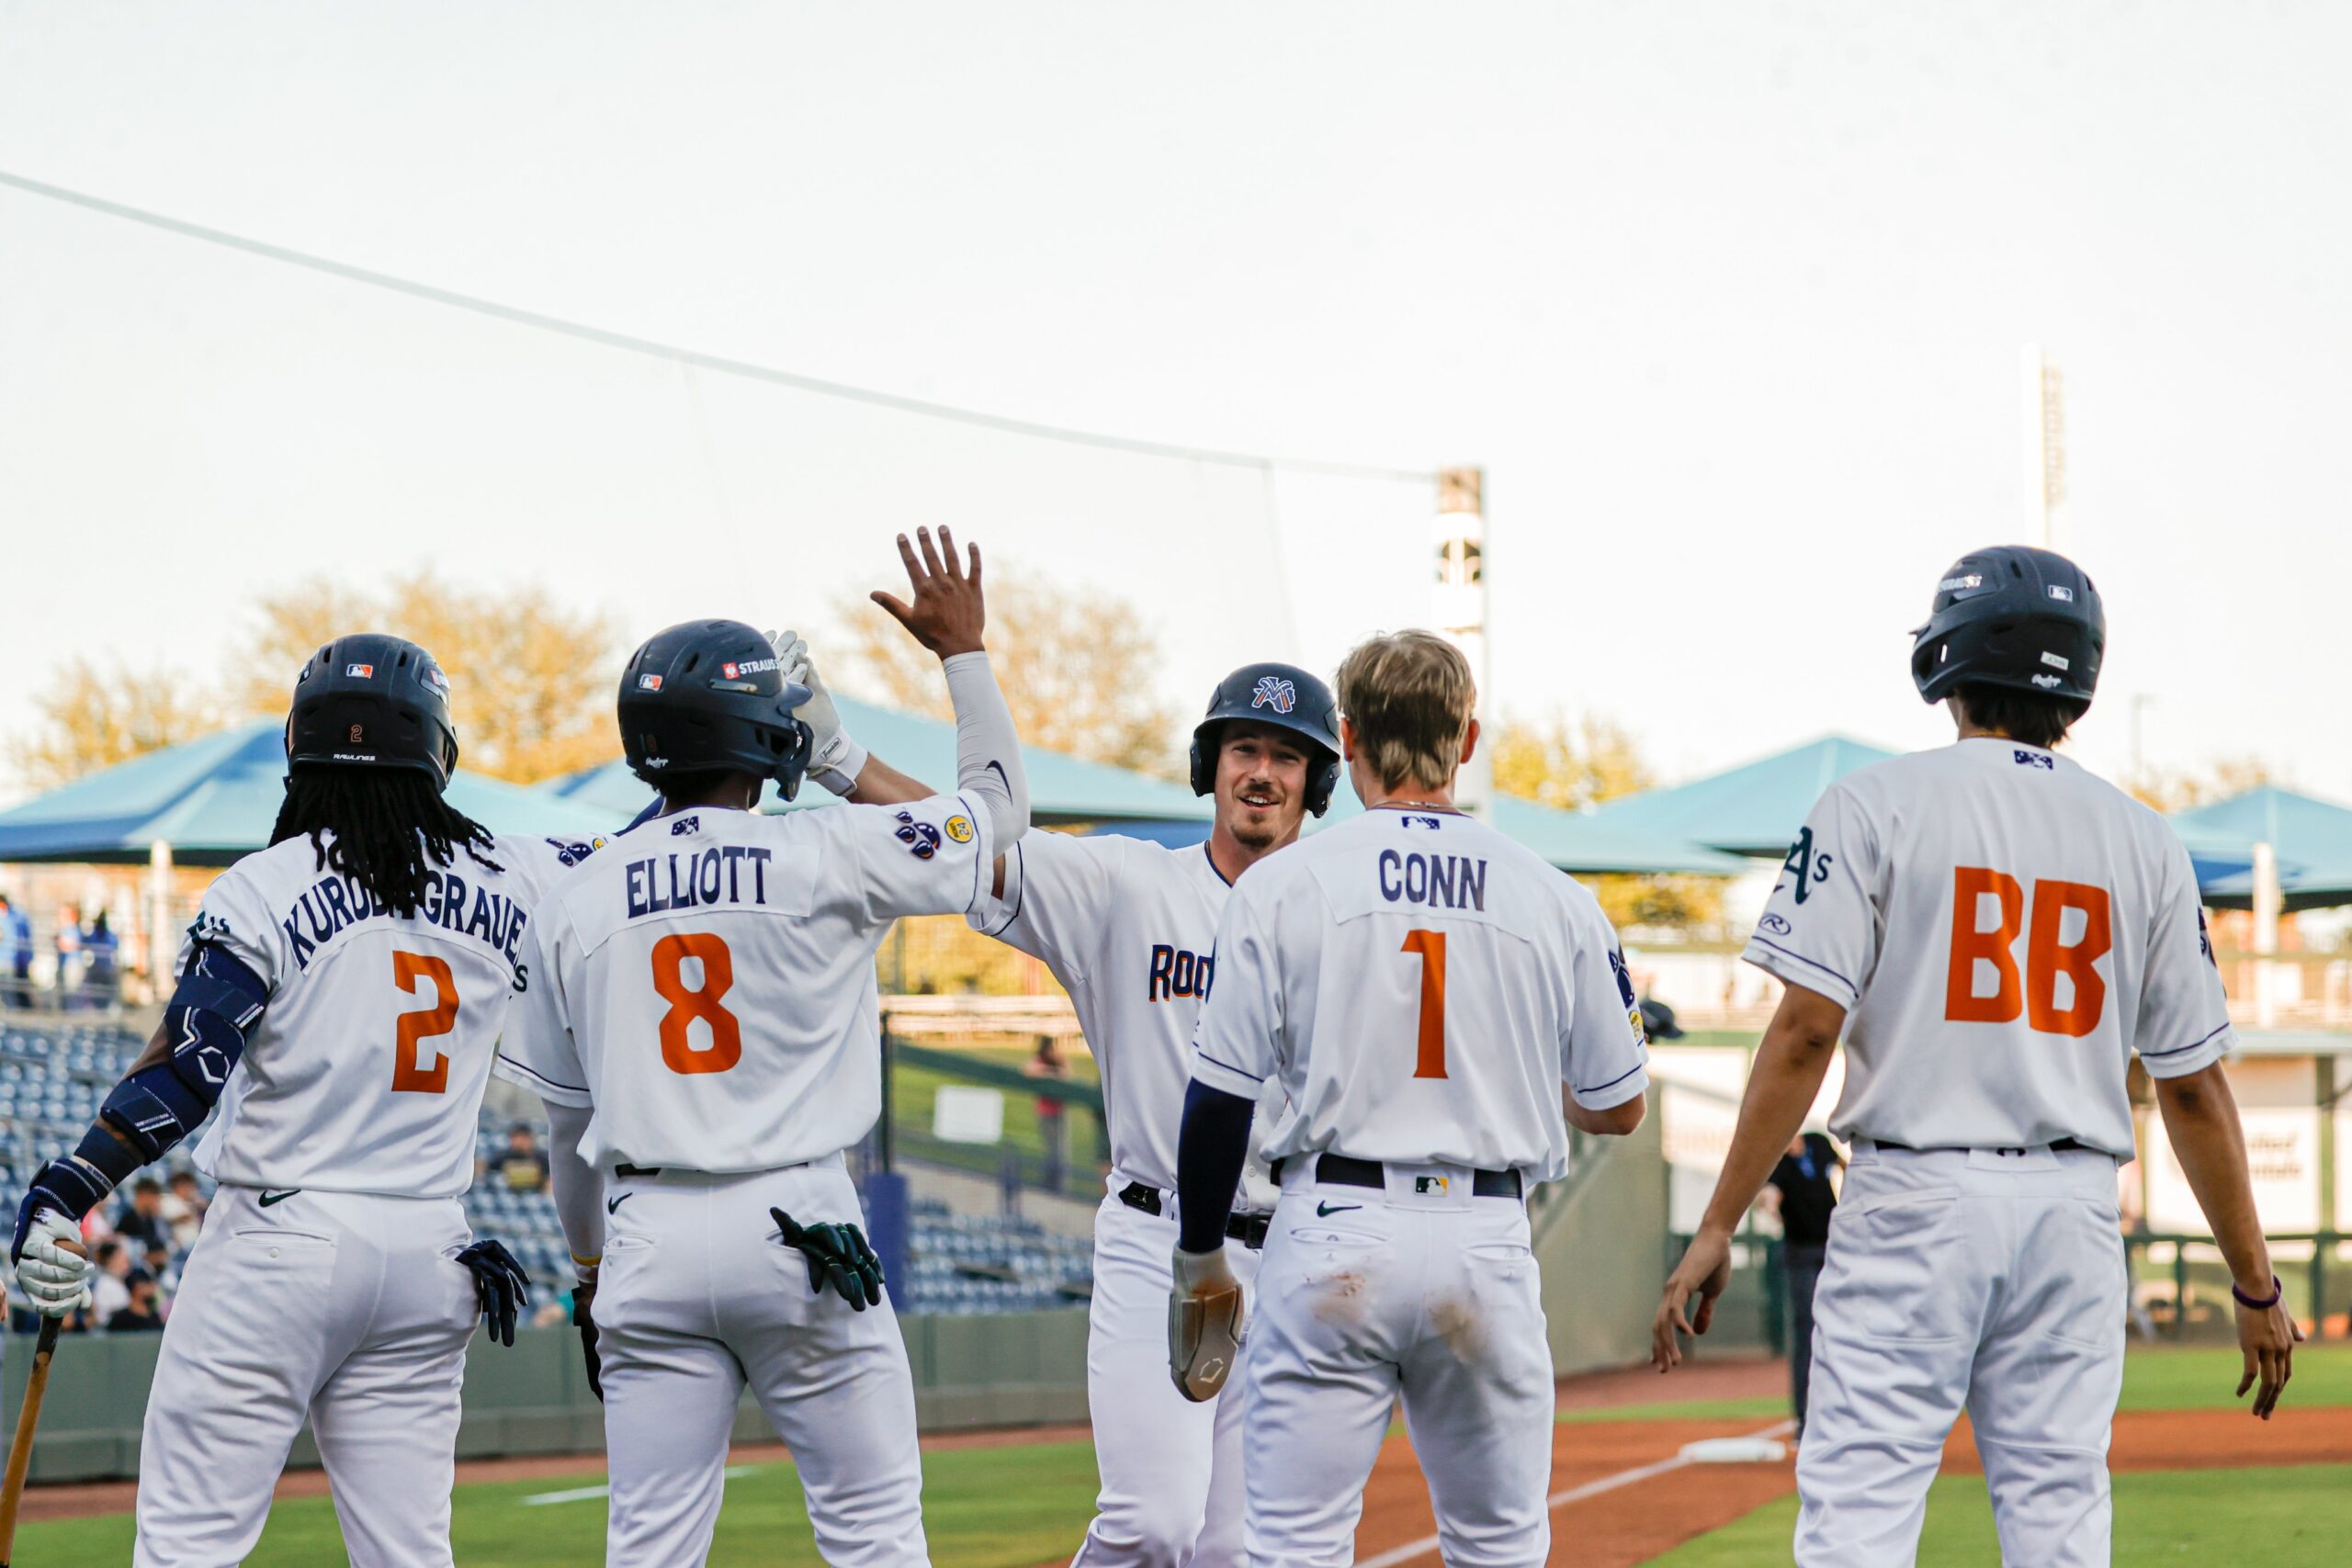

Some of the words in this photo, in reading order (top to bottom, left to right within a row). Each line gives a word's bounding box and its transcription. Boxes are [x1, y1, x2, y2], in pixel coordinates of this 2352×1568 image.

[351, 724, 363, 743] 2
[626, 845, 772, 919] ELLIOTT
[1379, 848, 1487, 912] CONN
[1945, 866, 2113, 1037] BB
[391, 950, 460, 1094] 2
[650, 932, 741, 1075] 8
[1401, 930, 1449, 1080] 1
